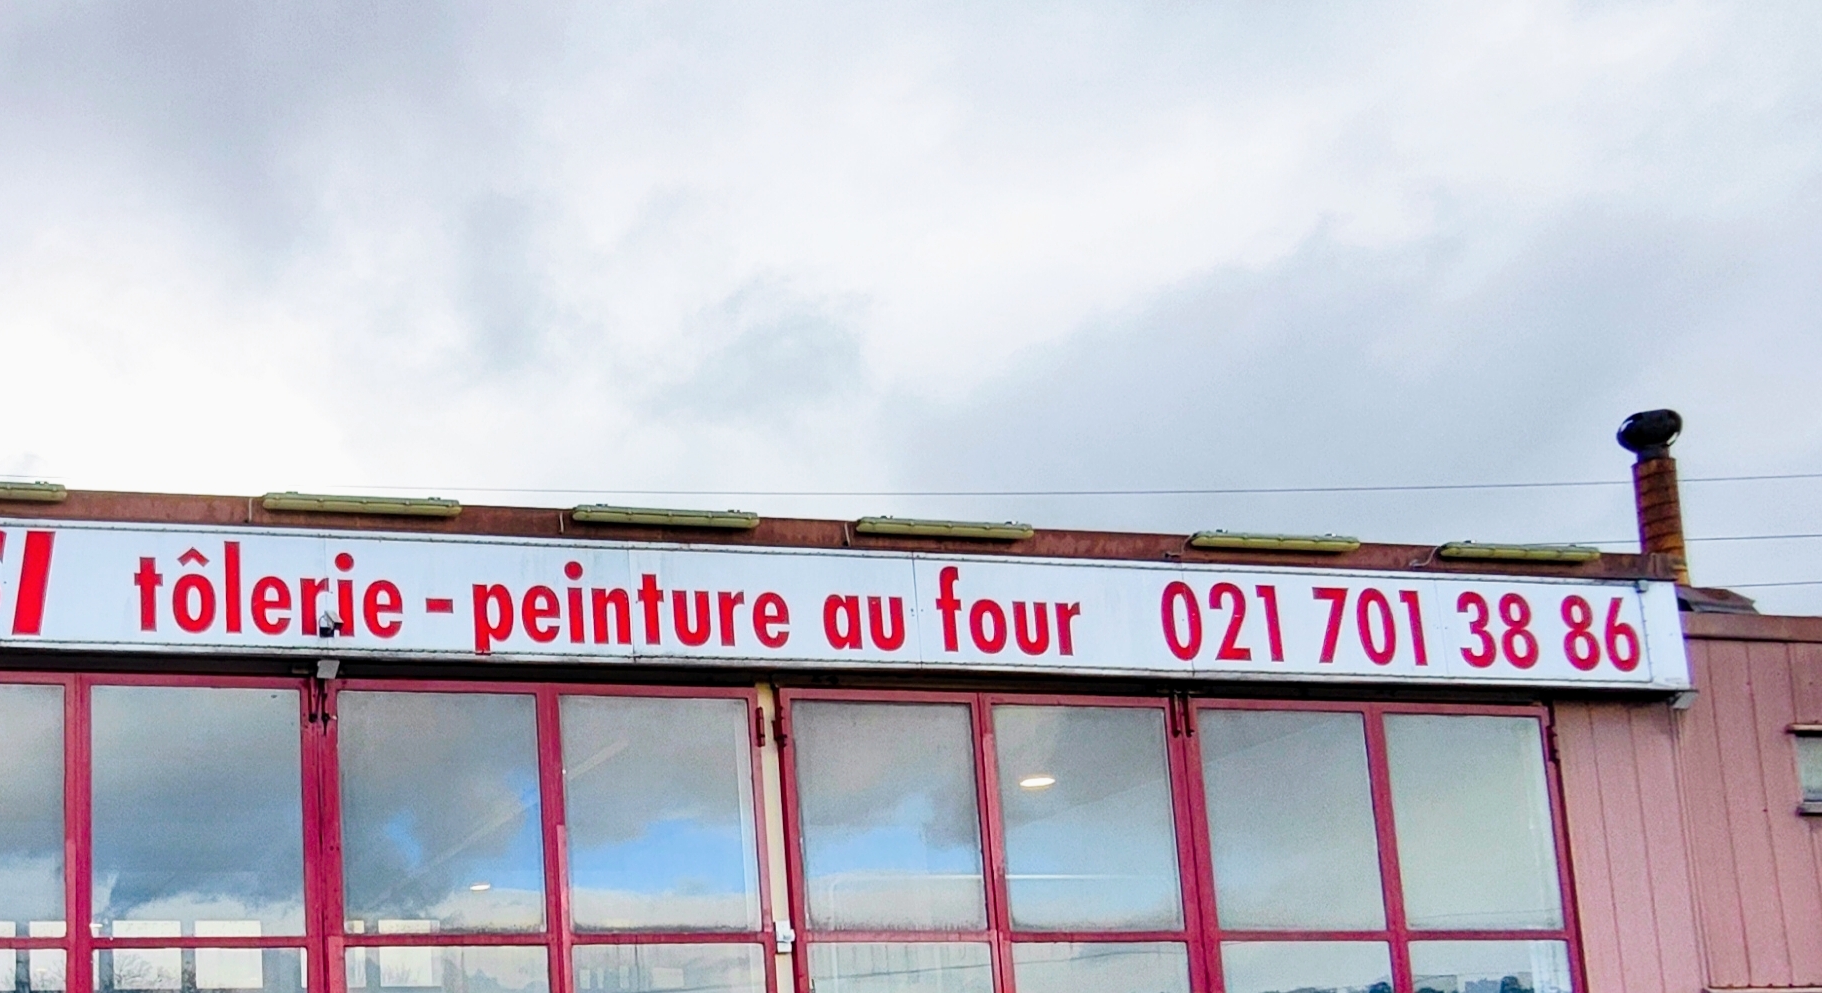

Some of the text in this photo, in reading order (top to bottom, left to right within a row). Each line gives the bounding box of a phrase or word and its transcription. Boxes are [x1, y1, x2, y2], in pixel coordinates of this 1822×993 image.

[135, 541, 403, 638] tôlerie
[473, 561, 789, 655] peinture
[823, 594, 906, 651] au
[936, 566, 1080, 656] four
[1162, 581, 1640, 671] 021 701 38 86
